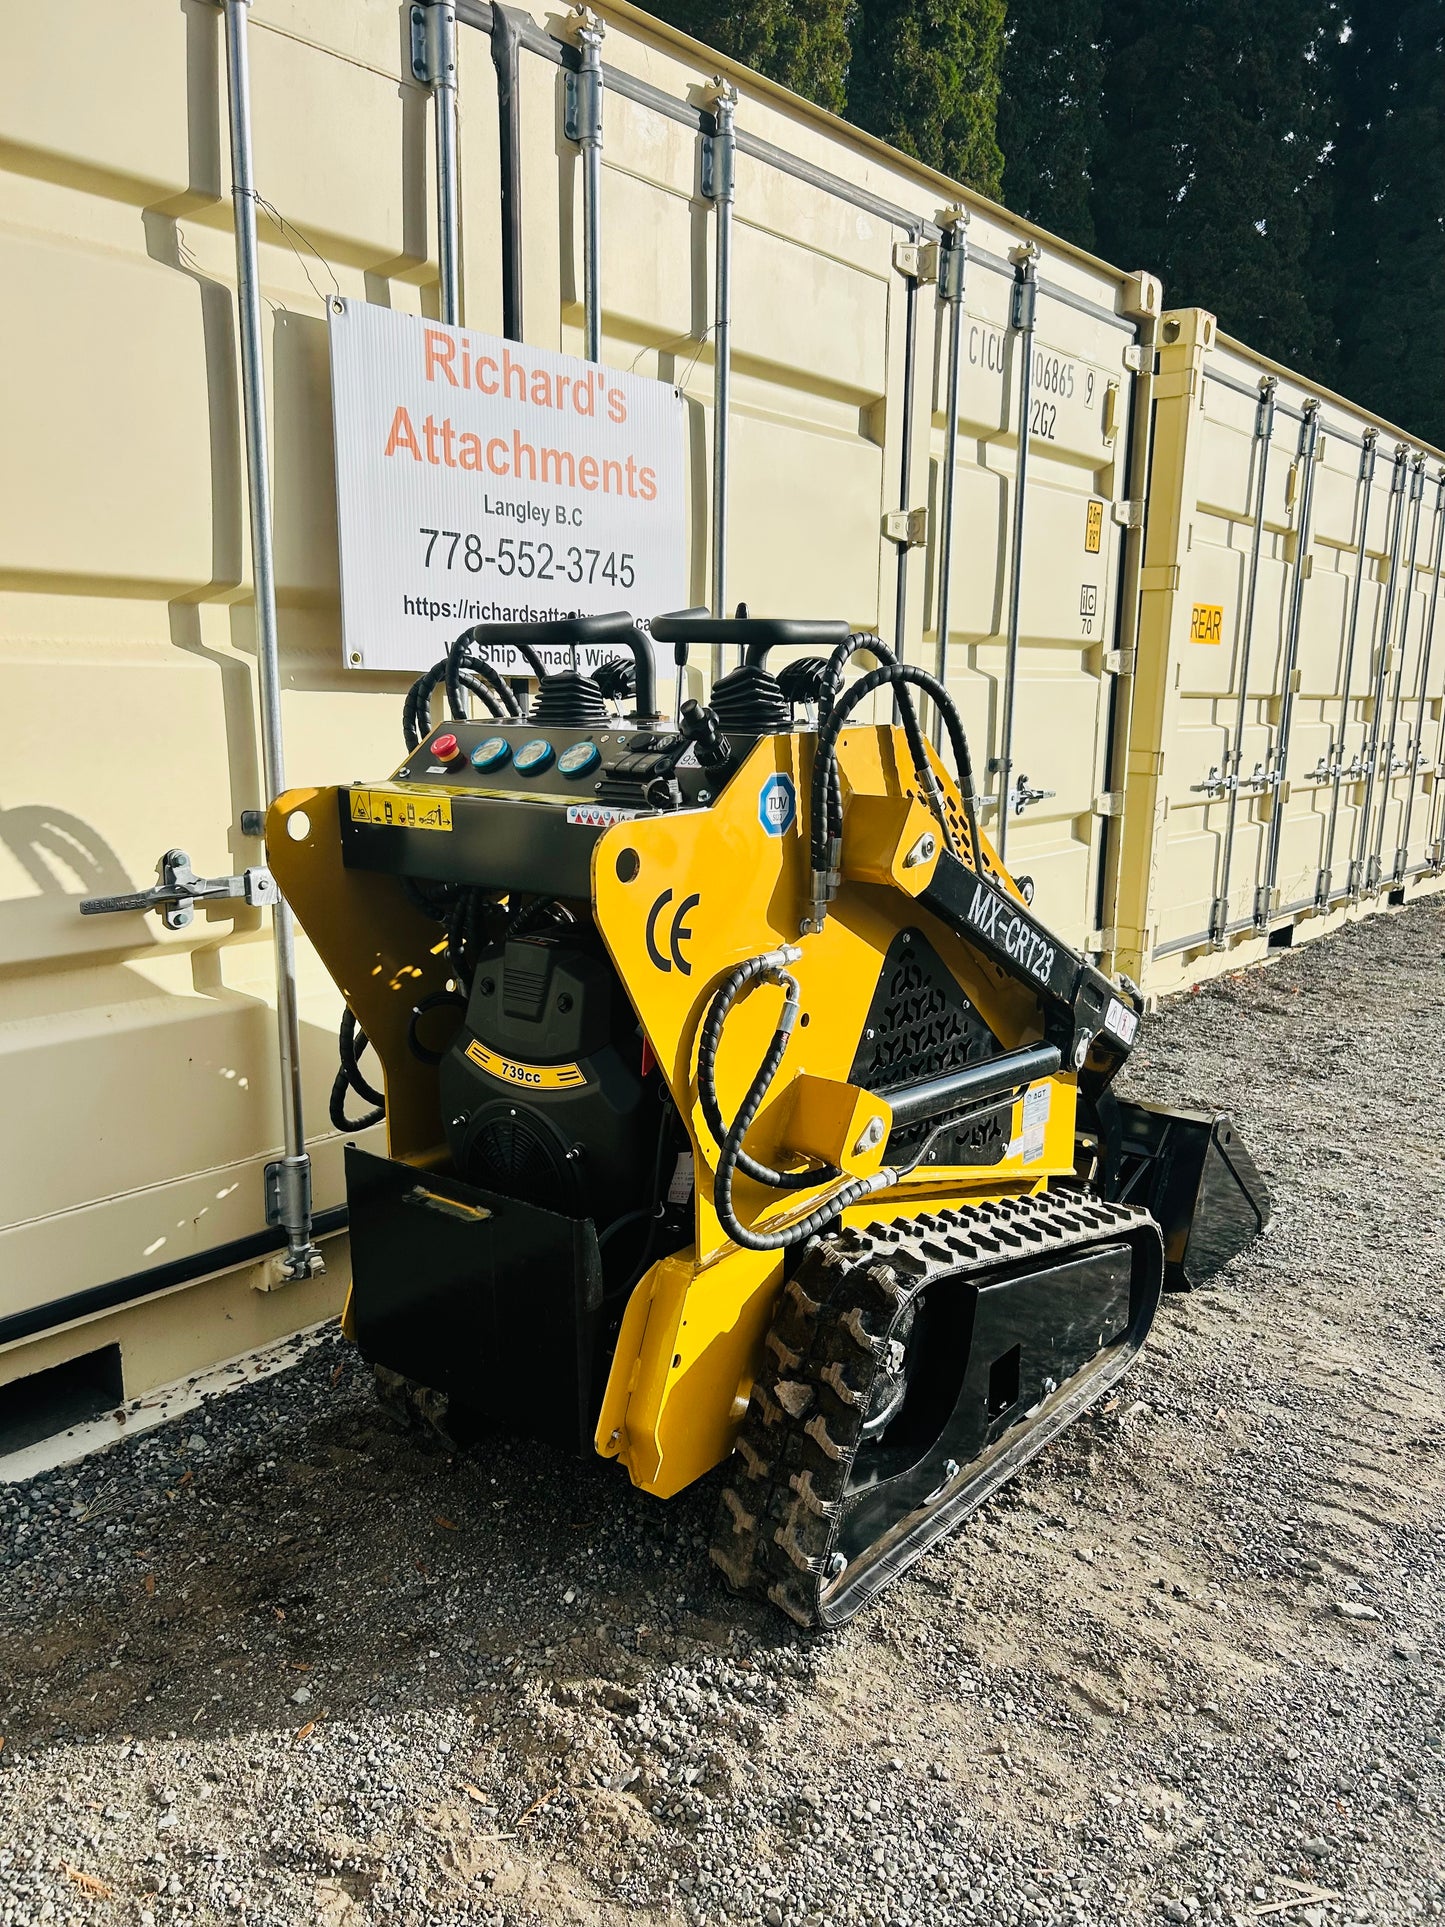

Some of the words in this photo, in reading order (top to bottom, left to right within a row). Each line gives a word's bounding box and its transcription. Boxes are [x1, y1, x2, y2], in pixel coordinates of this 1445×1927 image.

[424, 328, 627, 423] Richard's
[1086, 372, 1094, 404] 9
[384, 406, 658, 501] Attachments
[484, 494, 550, 526] Langley
[555, 505, 583, 527] B.C
[419, 528, 635, 589] 778-552-3745
[1081, 618, 1092, 634] 70
[1190, 607, 1222, 640] REAR
[478, 644, 517, 667] Ship
[645, 888, 701, 977] CE
[967, 883, 1056, 983] MX-CRT23
[502, 1062, 541, 1083] 739cc
